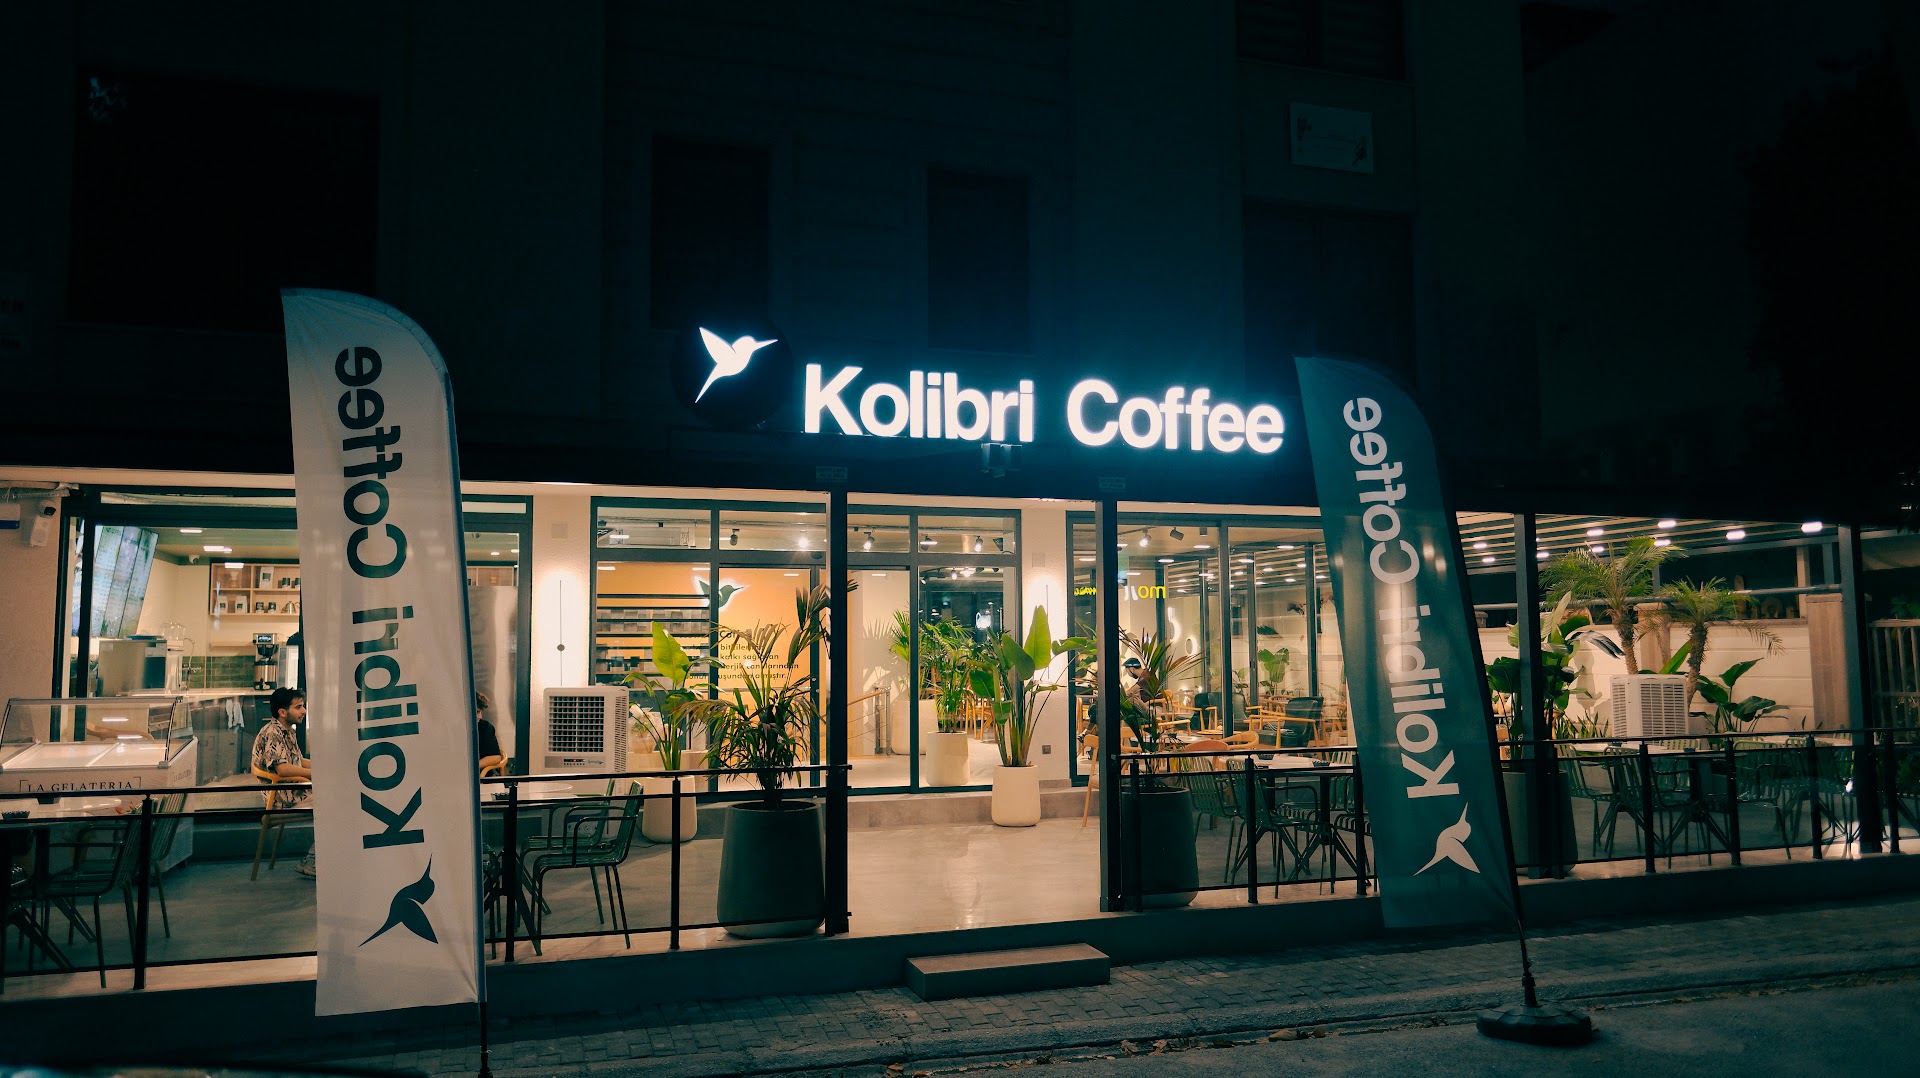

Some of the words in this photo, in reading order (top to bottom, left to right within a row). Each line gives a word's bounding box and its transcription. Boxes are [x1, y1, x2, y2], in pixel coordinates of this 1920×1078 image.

[803, 363, 1034, 443] Kolibri
[1066, 379, 1285, 453] Coffee
[28, 784, 45, 793] LA
[51, 781, 132, 792] GELATERIA
